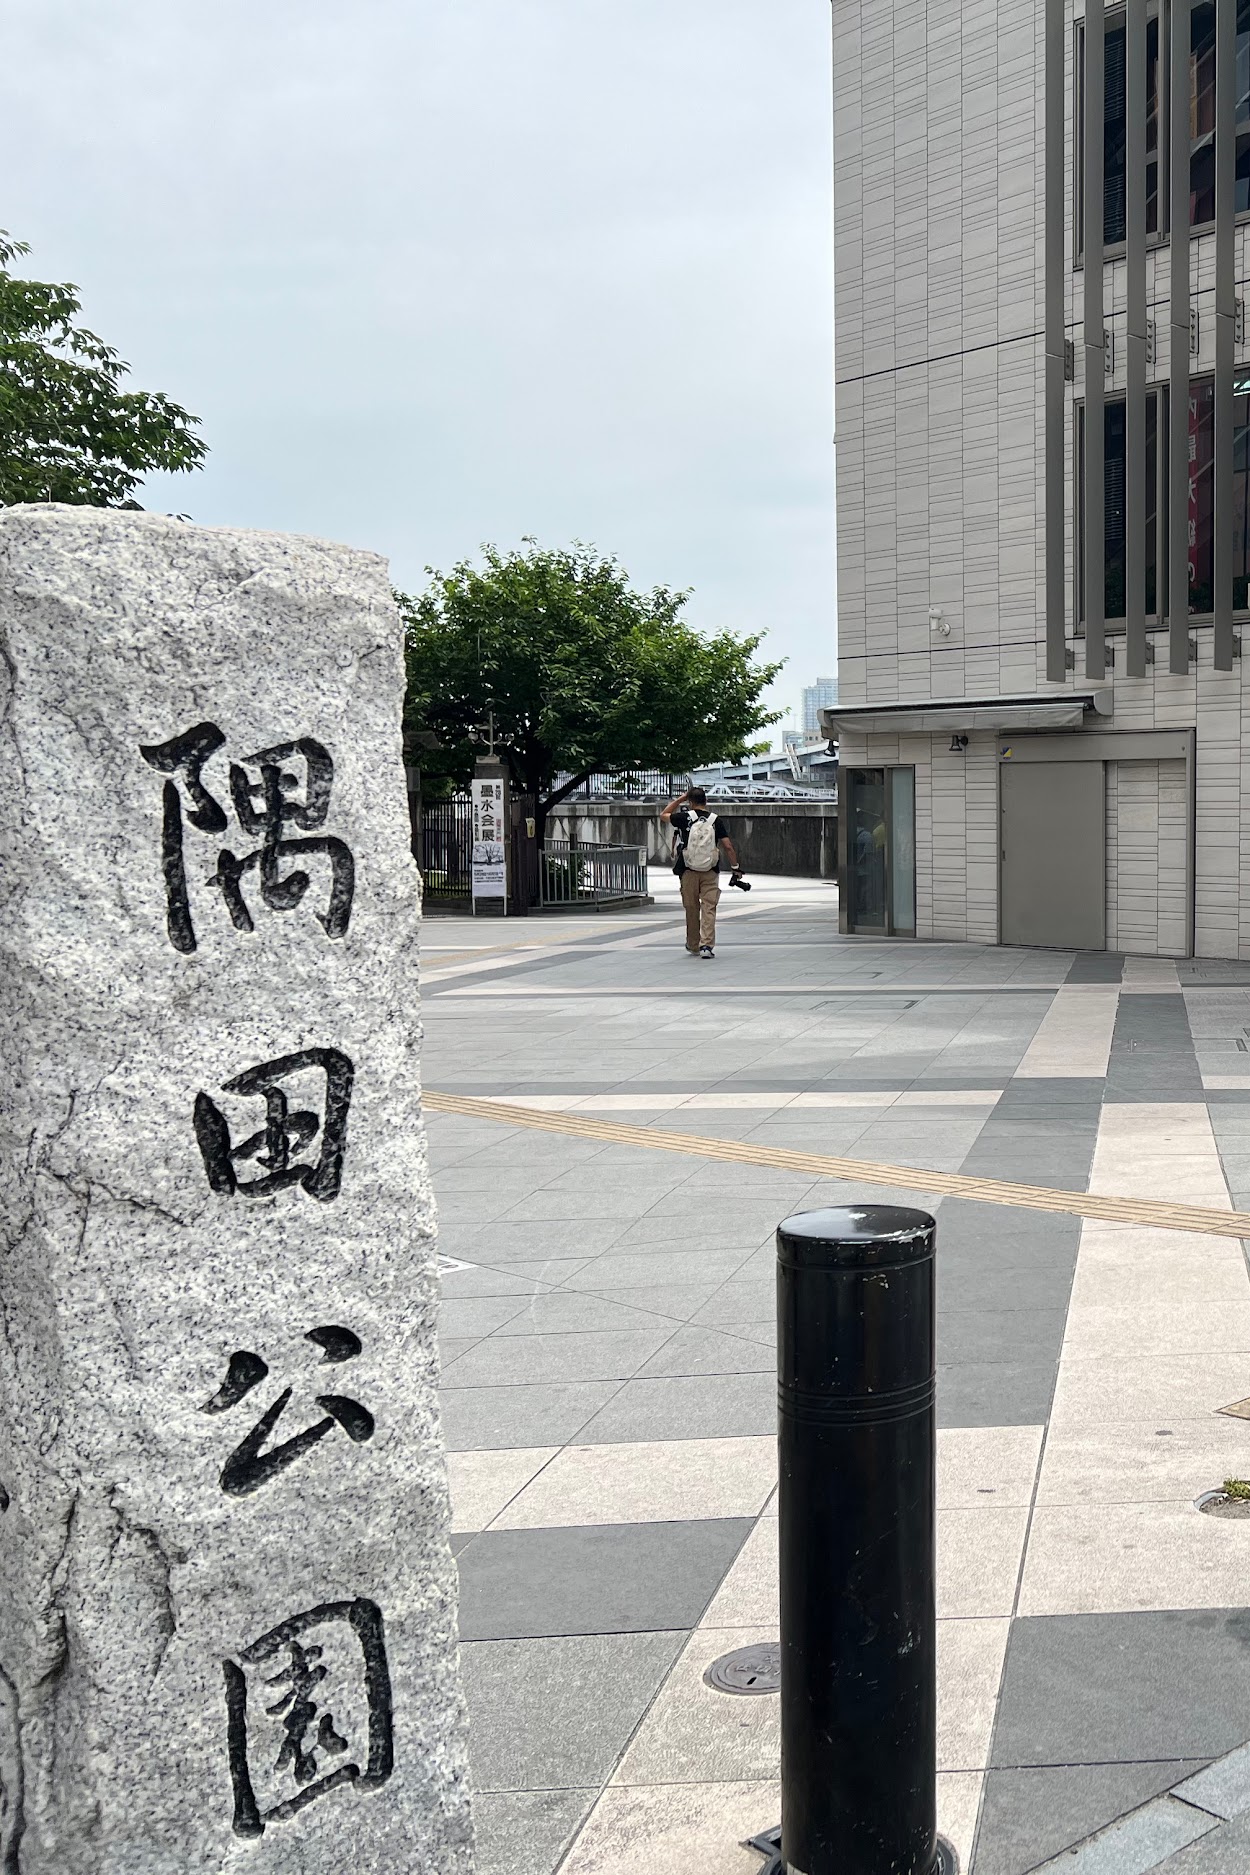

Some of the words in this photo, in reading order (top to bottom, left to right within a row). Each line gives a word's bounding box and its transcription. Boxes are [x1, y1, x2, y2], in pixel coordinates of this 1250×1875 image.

[481, 784, 495, 842] 墨水会展
[138, 721, 394, 1838] 隅田公園
